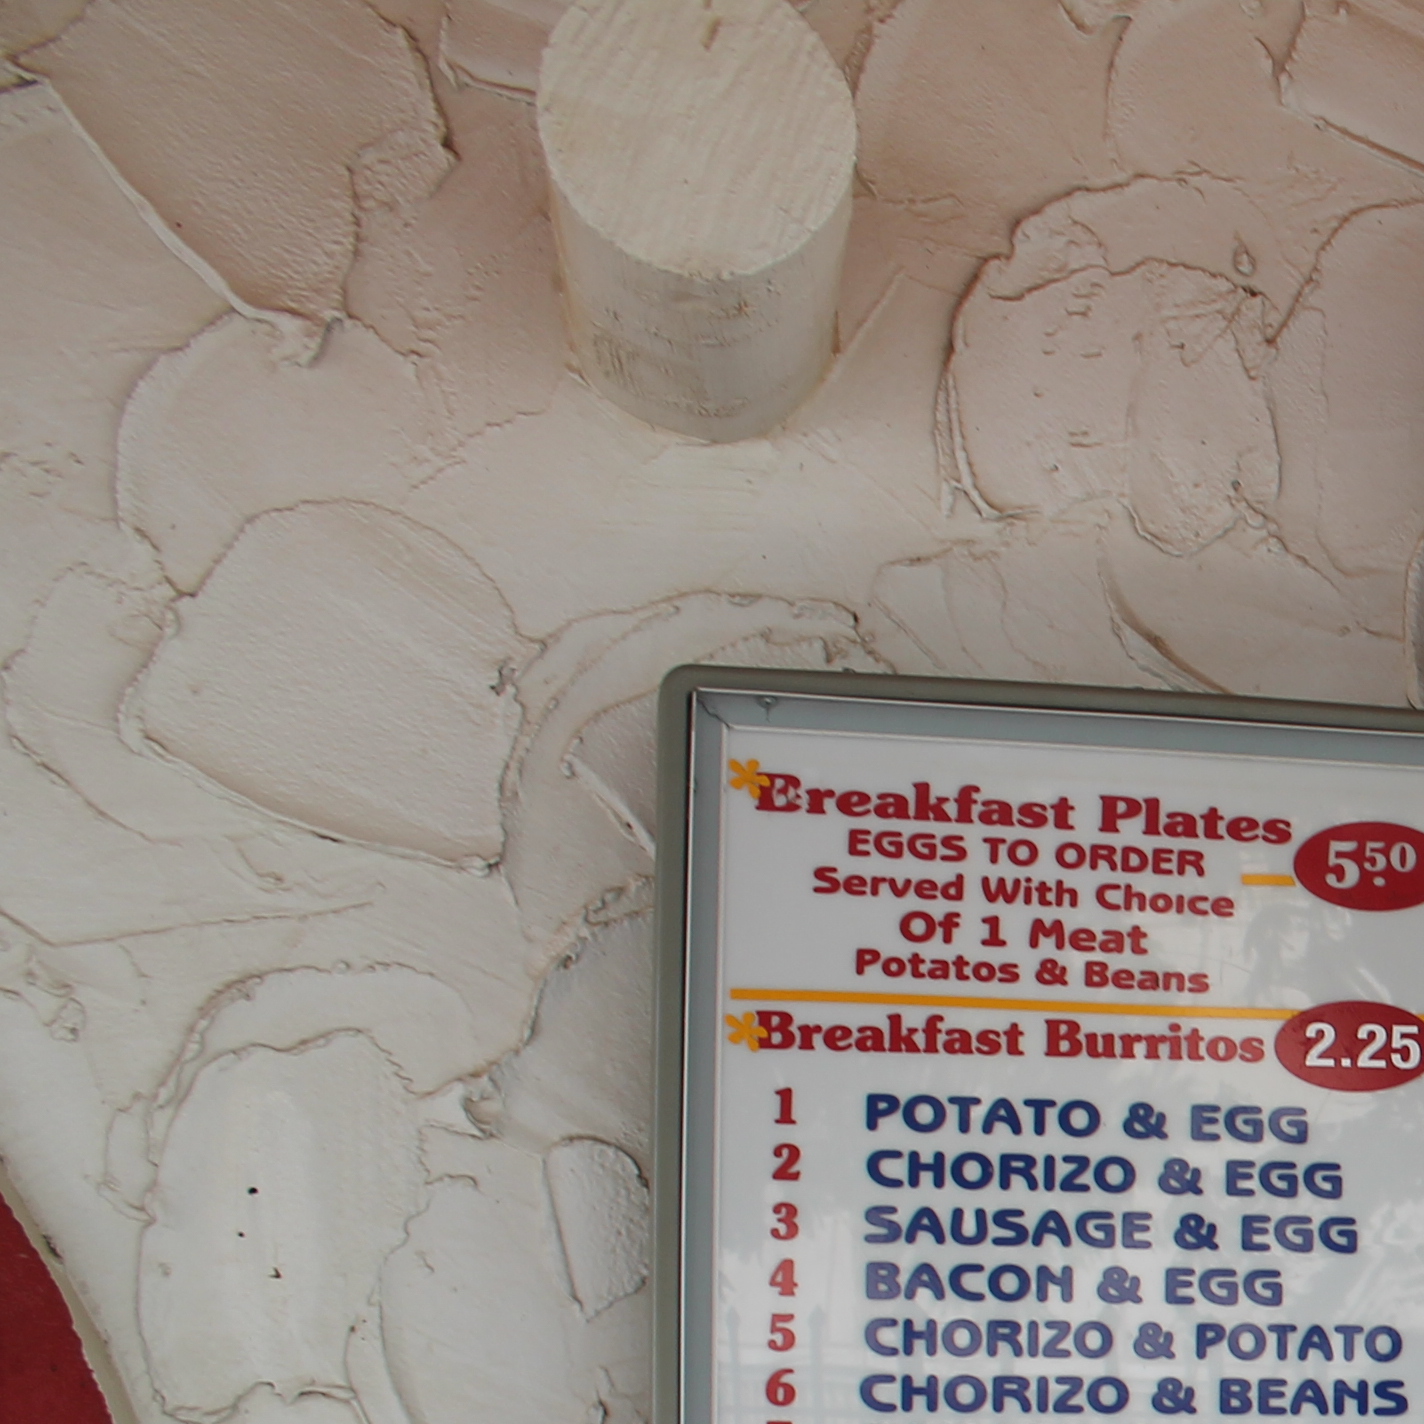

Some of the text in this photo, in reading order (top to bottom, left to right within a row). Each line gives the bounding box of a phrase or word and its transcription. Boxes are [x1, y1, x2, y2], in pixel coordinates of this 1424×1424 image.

[754, 771, 1076, 831] Breakfast
[1099, 795, 1293, 845] Plates
[849, 828, 1206, 878] EGGS TO ORDER
[814, 866, 1235, 918] Served With Choice
[899, 910, 1149, 955] Of 1 Meat
[856, 948, 1210, 994] Potatos & Beans
[755, 1010, 1422, 1071] Breakfast Burritos 2.25
[776, 1087, 1307, 1144] 1 POTATO & EGG
